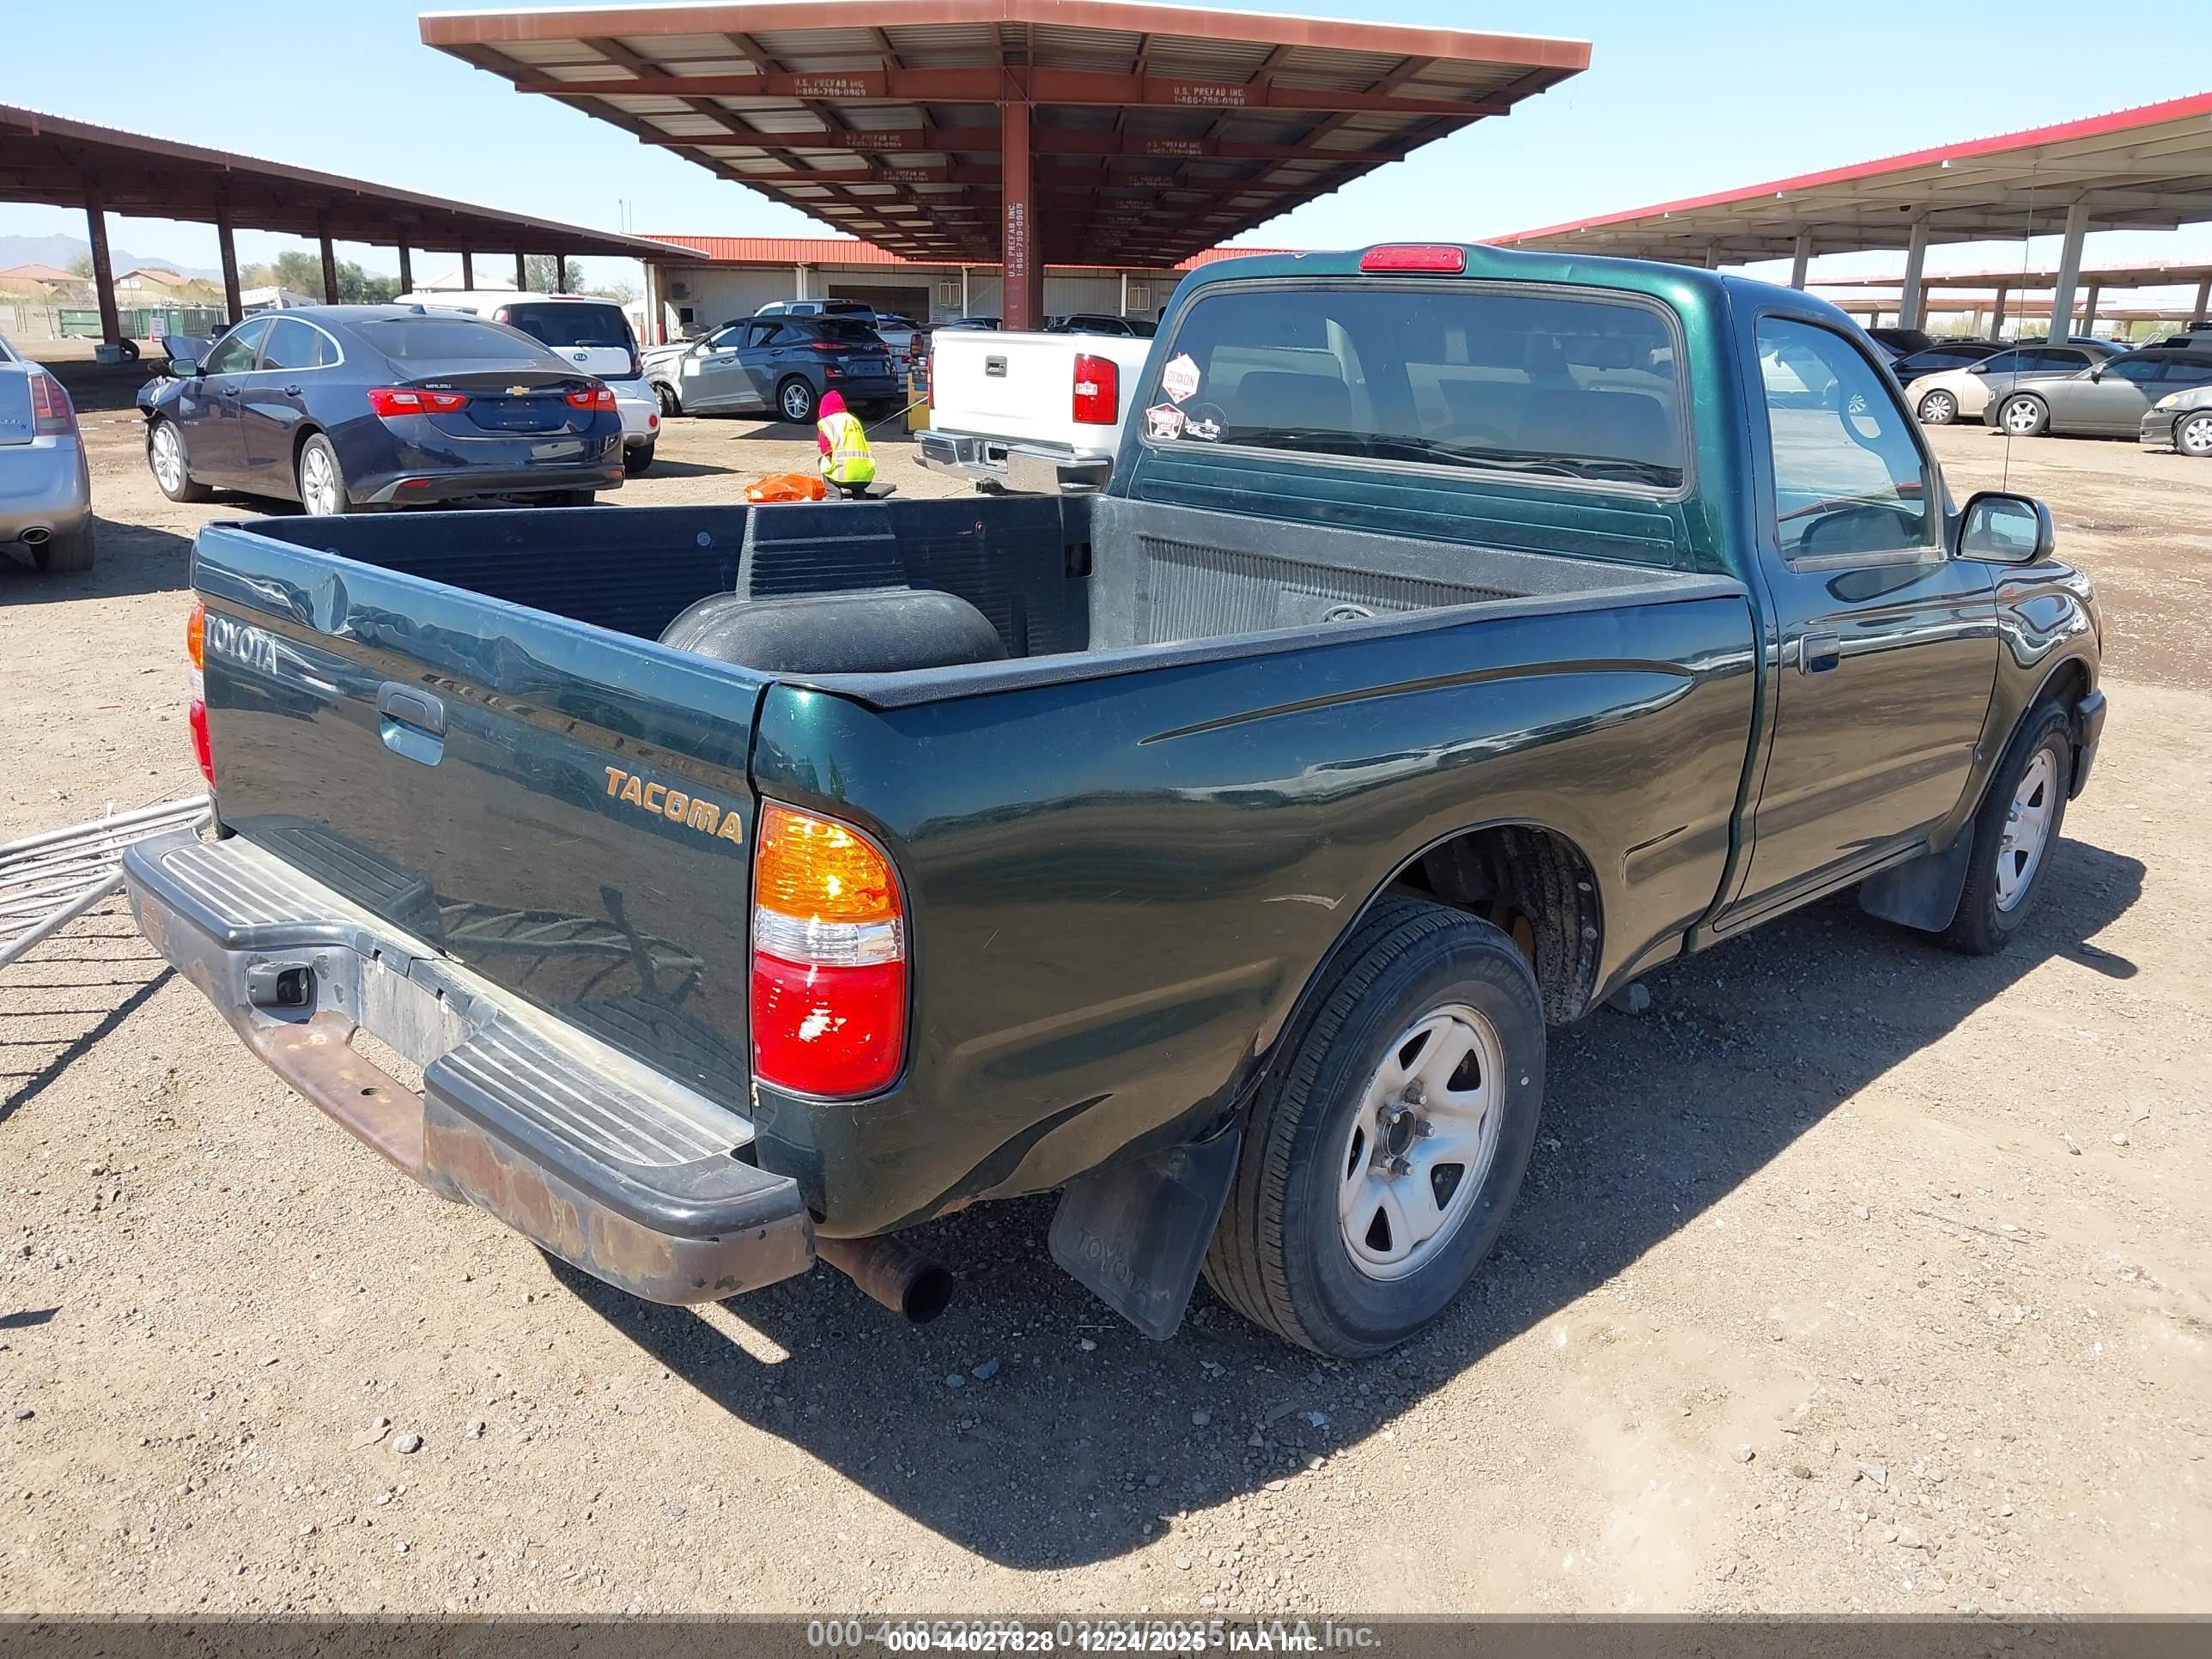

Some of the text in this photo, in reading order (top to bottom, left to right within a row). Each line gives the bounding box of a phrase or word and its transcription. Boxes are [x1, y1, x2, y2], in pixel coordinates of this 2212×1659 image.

[814, 79, 847, 88] PREFAB
[1174, 87, 1190, 95] U.S.
[1194, 88, 1226, 96] PREFAB
[1167, 370, 1196, 389] DIXXON
[204, 612, 278, 675] TOYOTA
[605, 766, 744, 846] TACOMA
